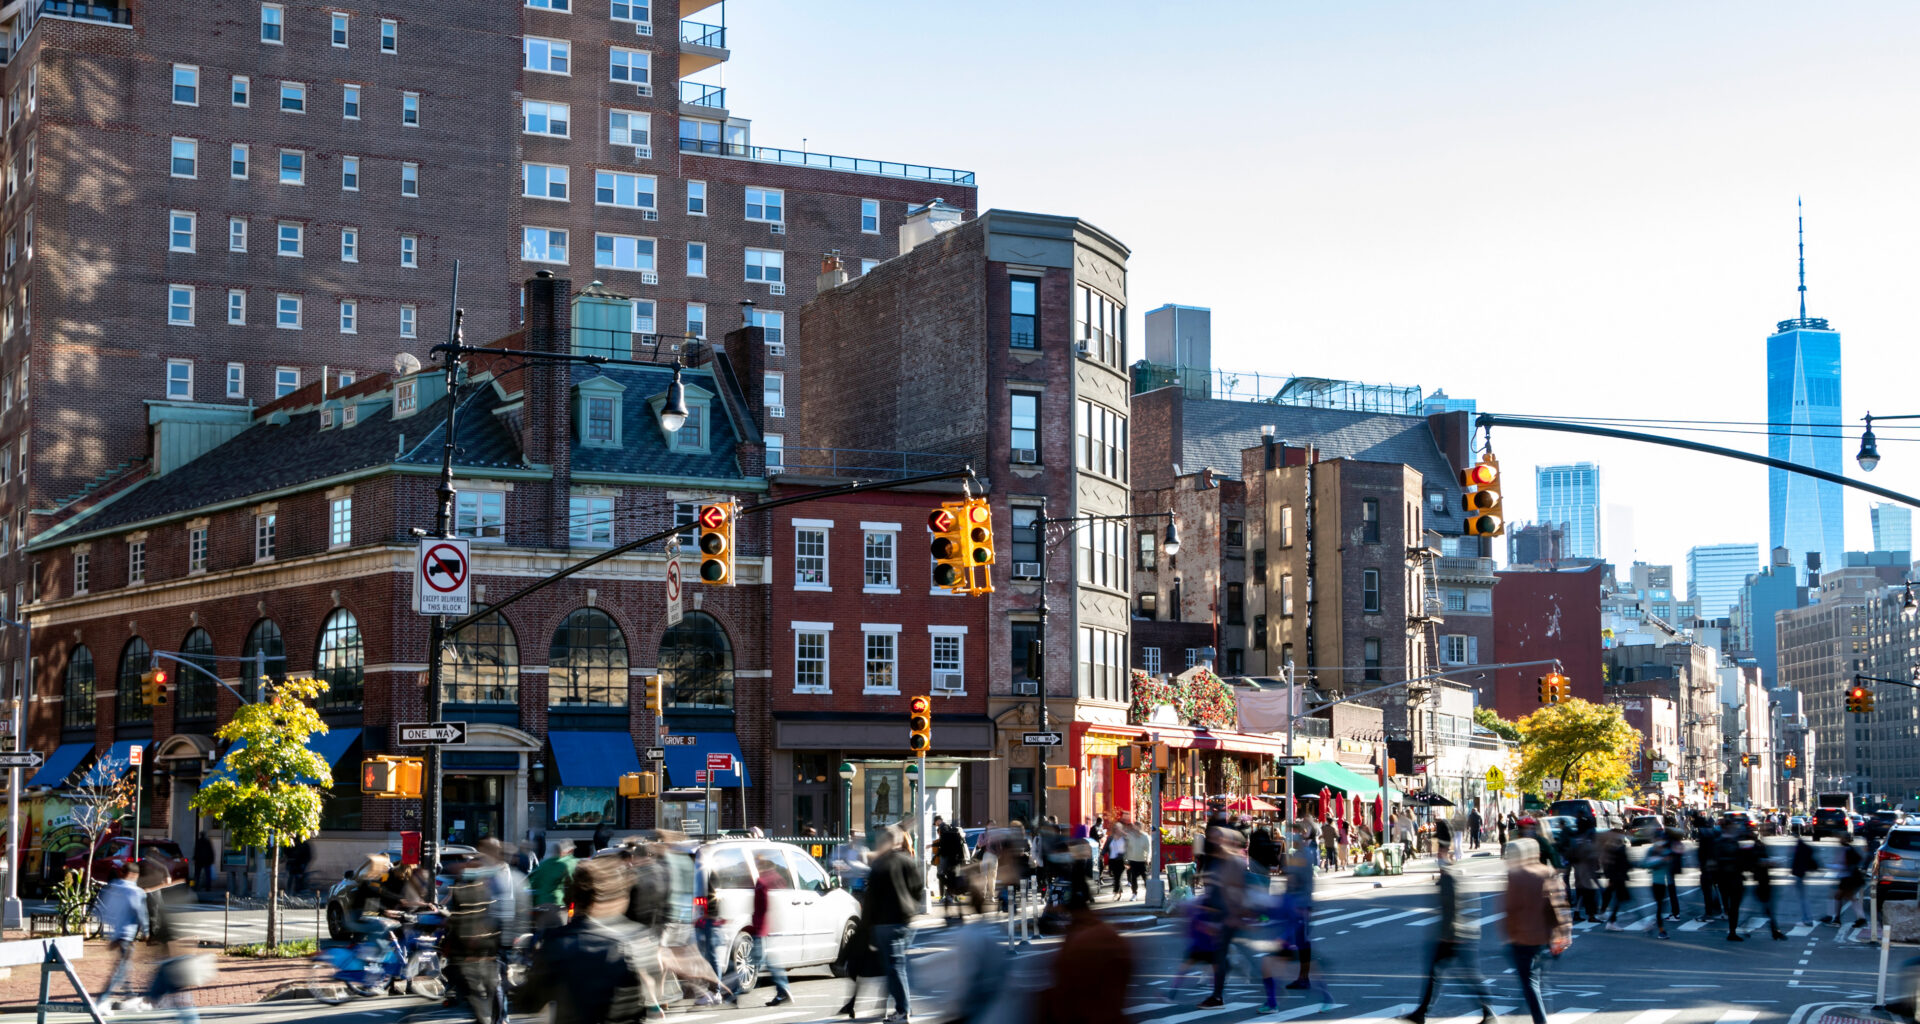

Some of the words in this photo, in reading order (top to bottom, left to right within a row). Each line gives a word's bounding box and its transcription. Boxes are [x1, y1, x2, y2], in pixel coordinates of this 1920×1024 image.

[408, 730, 427, 739] ONE
[435, 729, 456, 739] WAY
[664, 736, 685, 745] GROVE
[687, 736, 695, 745] ST
[21, 755, 37, 763] WAY
[405, 809, 414, 817] 74
